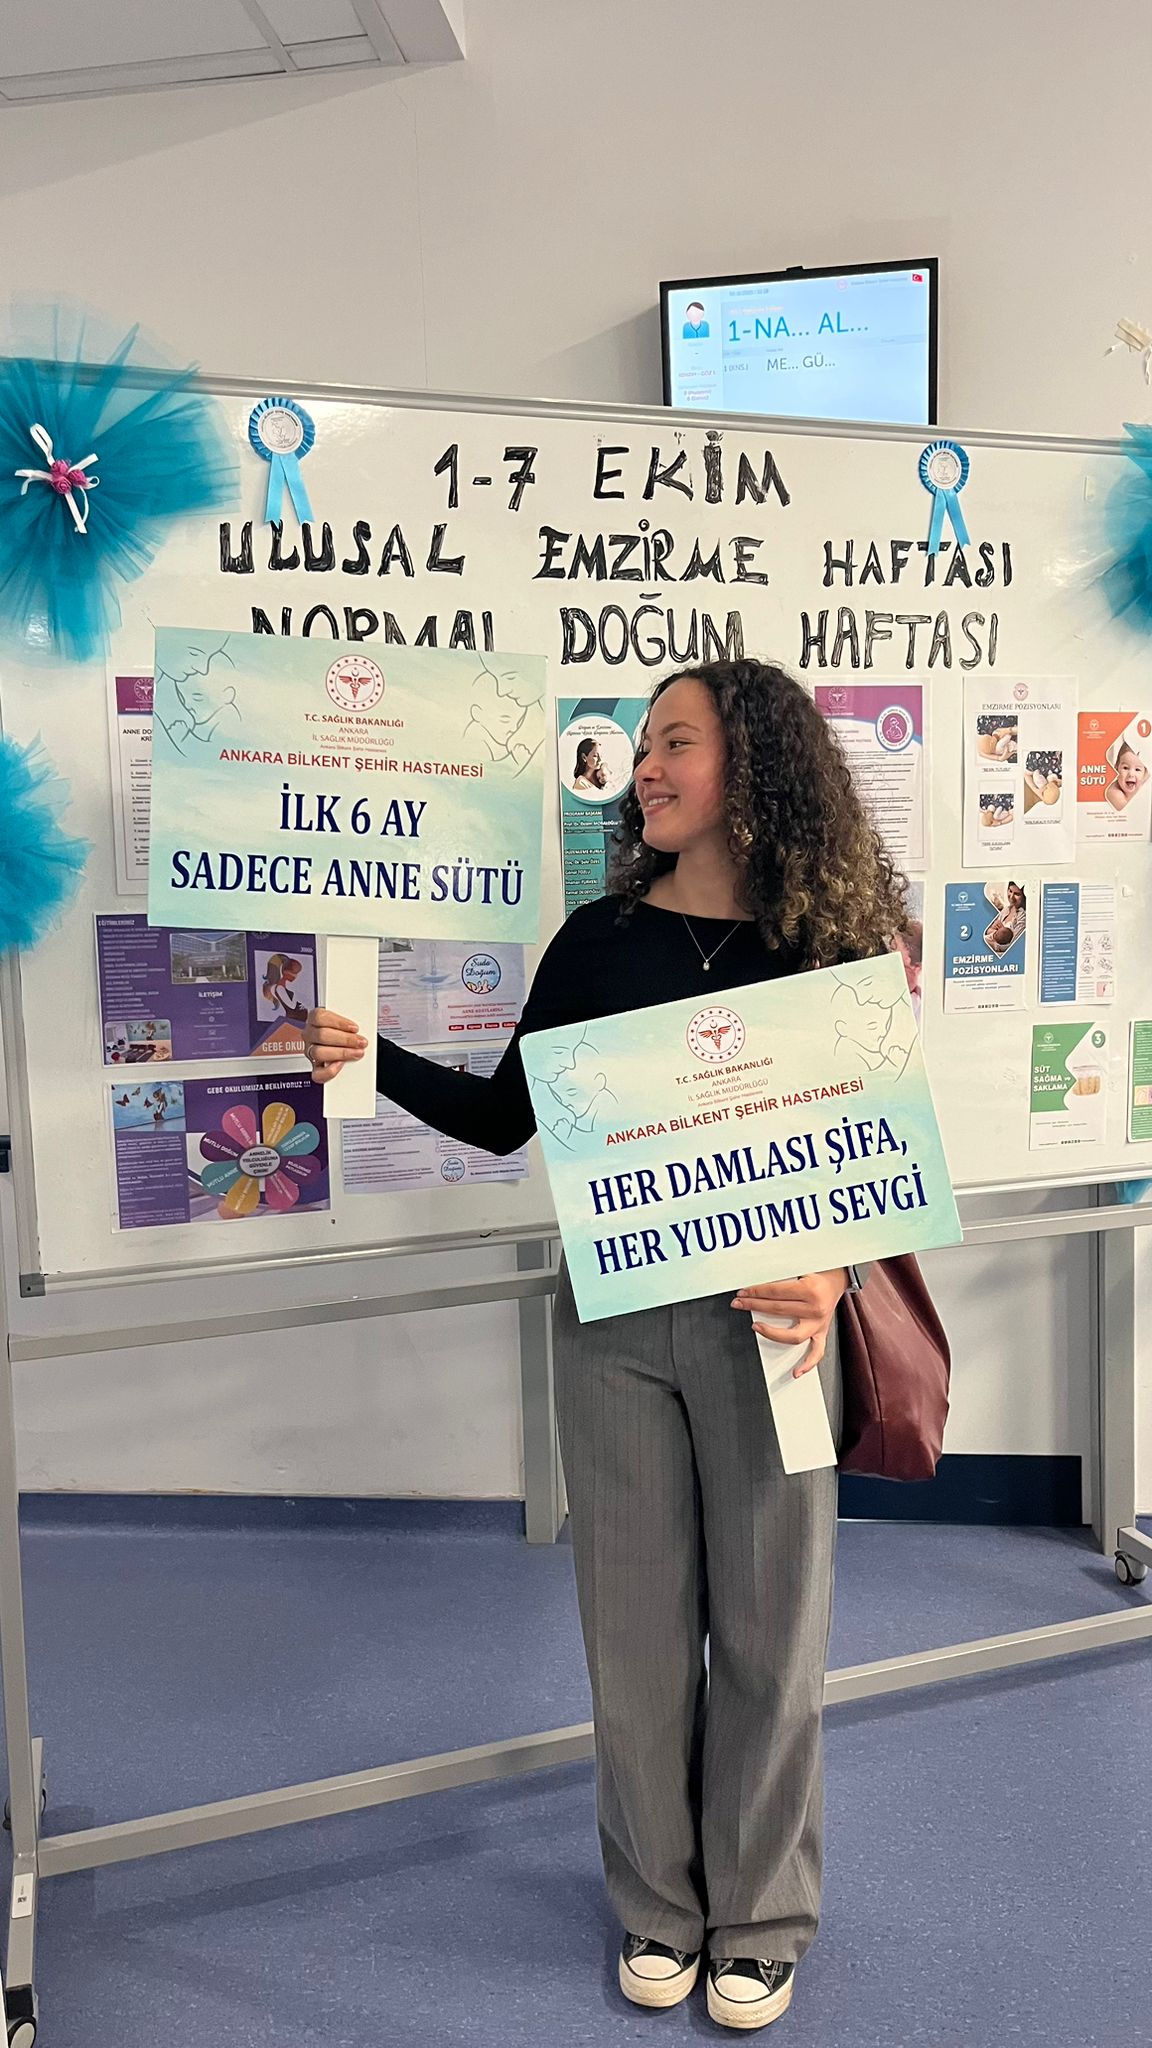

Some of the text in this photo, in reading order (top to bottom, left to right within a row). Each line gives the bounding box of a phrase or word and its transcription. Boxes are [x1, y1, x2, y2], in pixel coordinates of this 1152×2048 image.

[728, 311, 869, 342] 1-NA... AL...
[766, 357, 799, 371] ME...
[802, 352, 836, 368] GÜ...
[593, 430, 791, 508] EKİM
[219, 518, 1013, 588] ULUSAL EMZİRME HAFTASI
[559, 592, 745, 667] DOĞUM
[799, 606, 999, 670] HAFTASI
[322, 714, 355, 725] SAĞLIK
[355, 716, 404, 728] BAKANLIĞI
[338, 727, 369, 735] ANKARA
[219, 748, 483, 778] ANKARA BİLKENT ŞEHİR HASTANESİ
[1080, 765, 1107, 774] ANNE
[1080, 775, 1106, 786] SÜTÜ
[278, 782, 428, 839] İLK 6 AY
[170, 849, 313, 895] SADECE
[320, 857, 422, 902] ANNE
[430, 856, 525, 906] SÜTÜ
[960, 925, 968, 938] 2
[952, 953, 994, 965] EMZİRME
[952, 964, 1019, 976] POZİSYONLARI
[1094, 1033, 1102, 1045] 3
[262, 1042, 284, 1052] GEBE
[675, 1057, 774, 1085] T.C. SAĞLIK BAKANLIĞI
[1034, 1065, 1051, 1074] SÜT
[711, 1075, 742, 1087] ANKARA
[1033, 1073, 1063, 1083] SAĞMA
[207, 1086, 224, 1094] GEBE
[1033, 1083, 1068, 1092] SAKLAMA
[605, 1076, 865, 1146] ANKARA BİLKENT ŞEHİR HASTANESİ
[588, 1116, 909, 1216] HER DAMLASI ŞİFA,
[592, 1162, 929, 1276] HER YUDUMU SEVGİ
